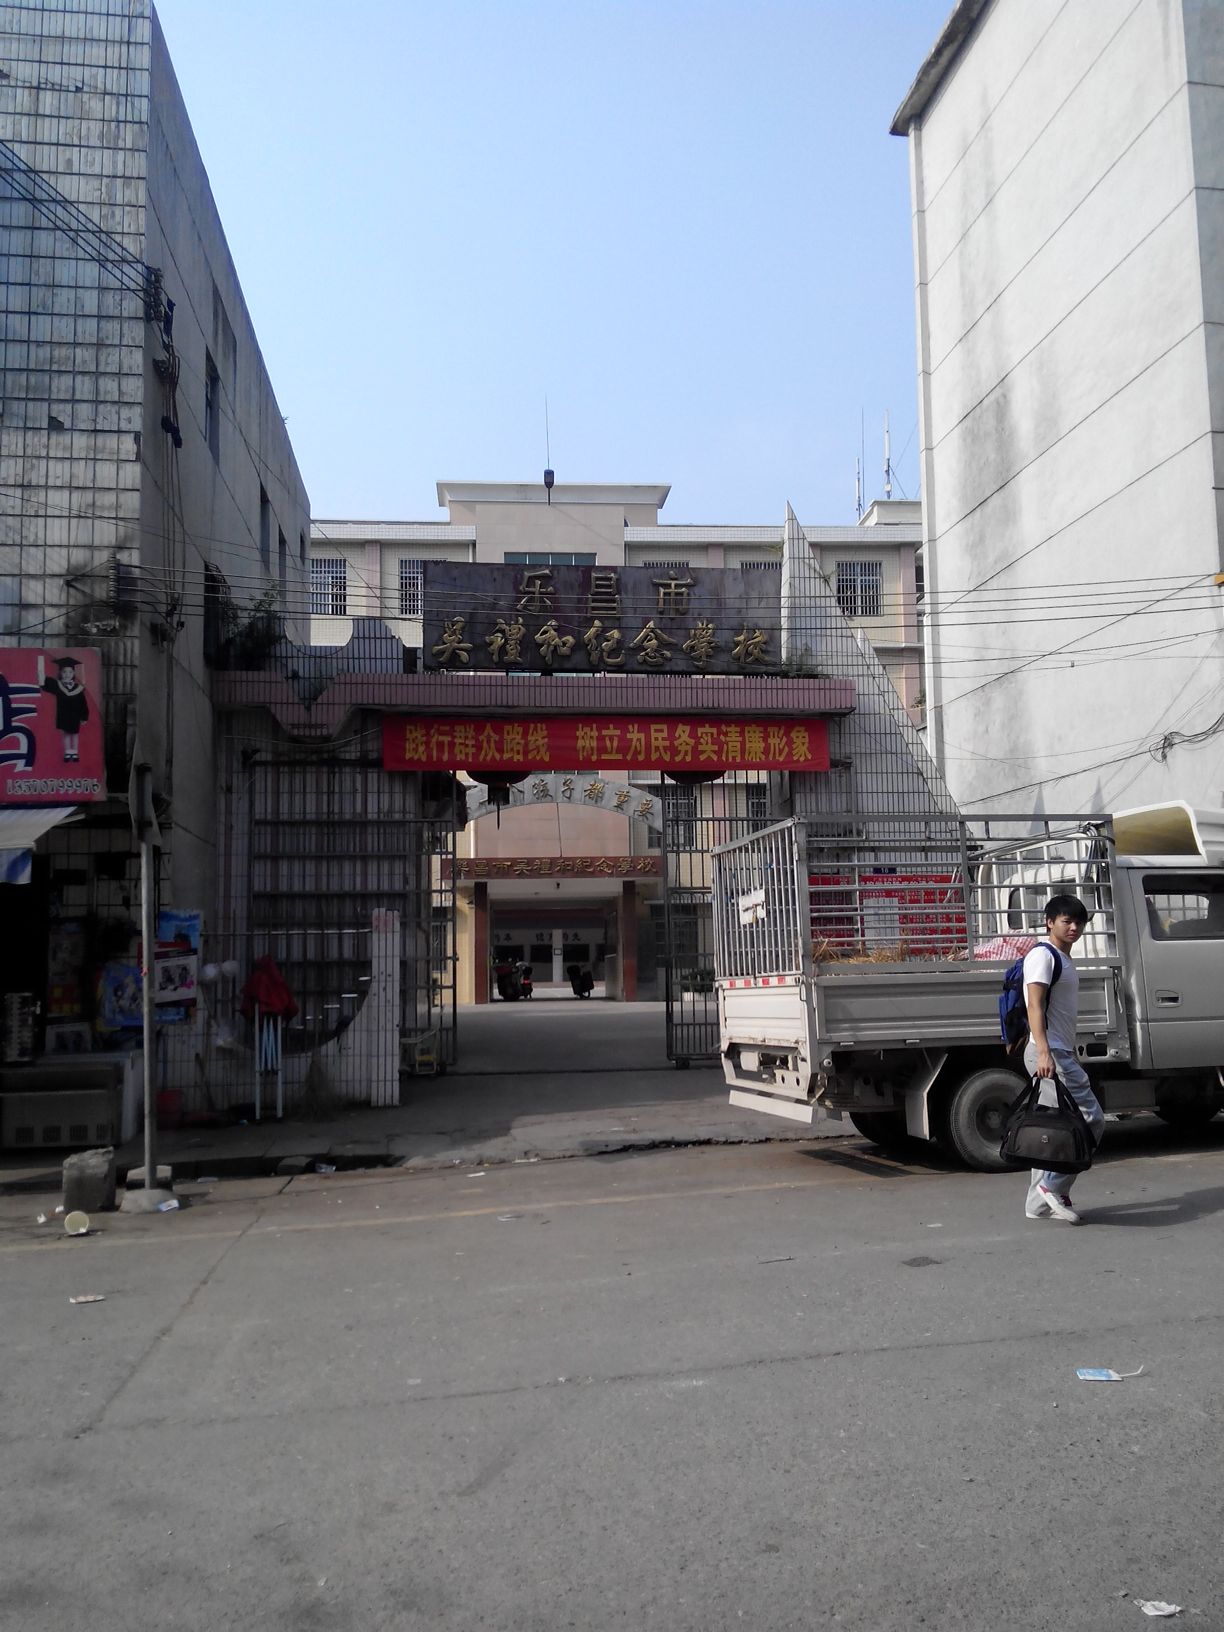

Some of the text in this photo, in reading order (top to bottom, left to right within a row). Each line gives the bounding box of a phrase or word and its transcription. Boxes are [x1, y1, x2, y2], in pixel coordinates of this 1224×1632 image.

[516, 570, 696, 616] 乐昌市
[405, 722, 812, 762] 践行群众路线 树立为民务实清廉形象
